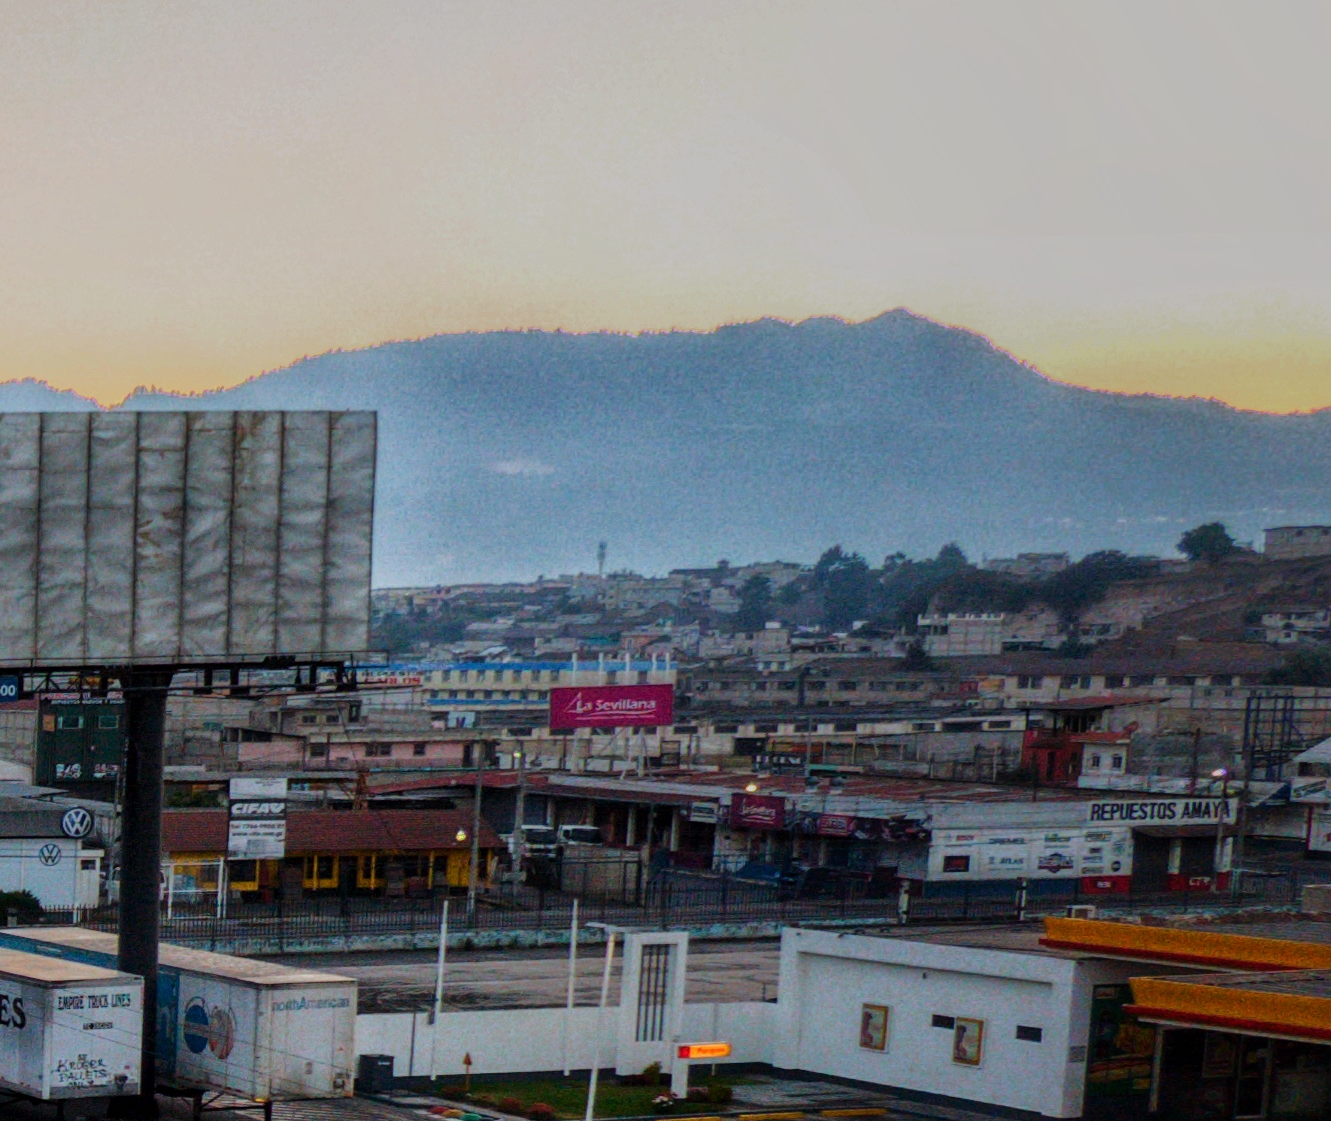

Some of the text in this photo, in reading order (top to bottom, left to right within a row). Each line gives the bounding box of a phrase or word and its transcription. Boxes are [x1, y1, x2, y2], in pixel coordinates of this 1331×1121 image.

[595, 698, 656, 711] Sevillana
[1091, 800, 1231, 821] REPUESTOS AMAYA
[57, 995, 85, 1011] EMPIRE
[111, 993, 132, 1008] LINES
